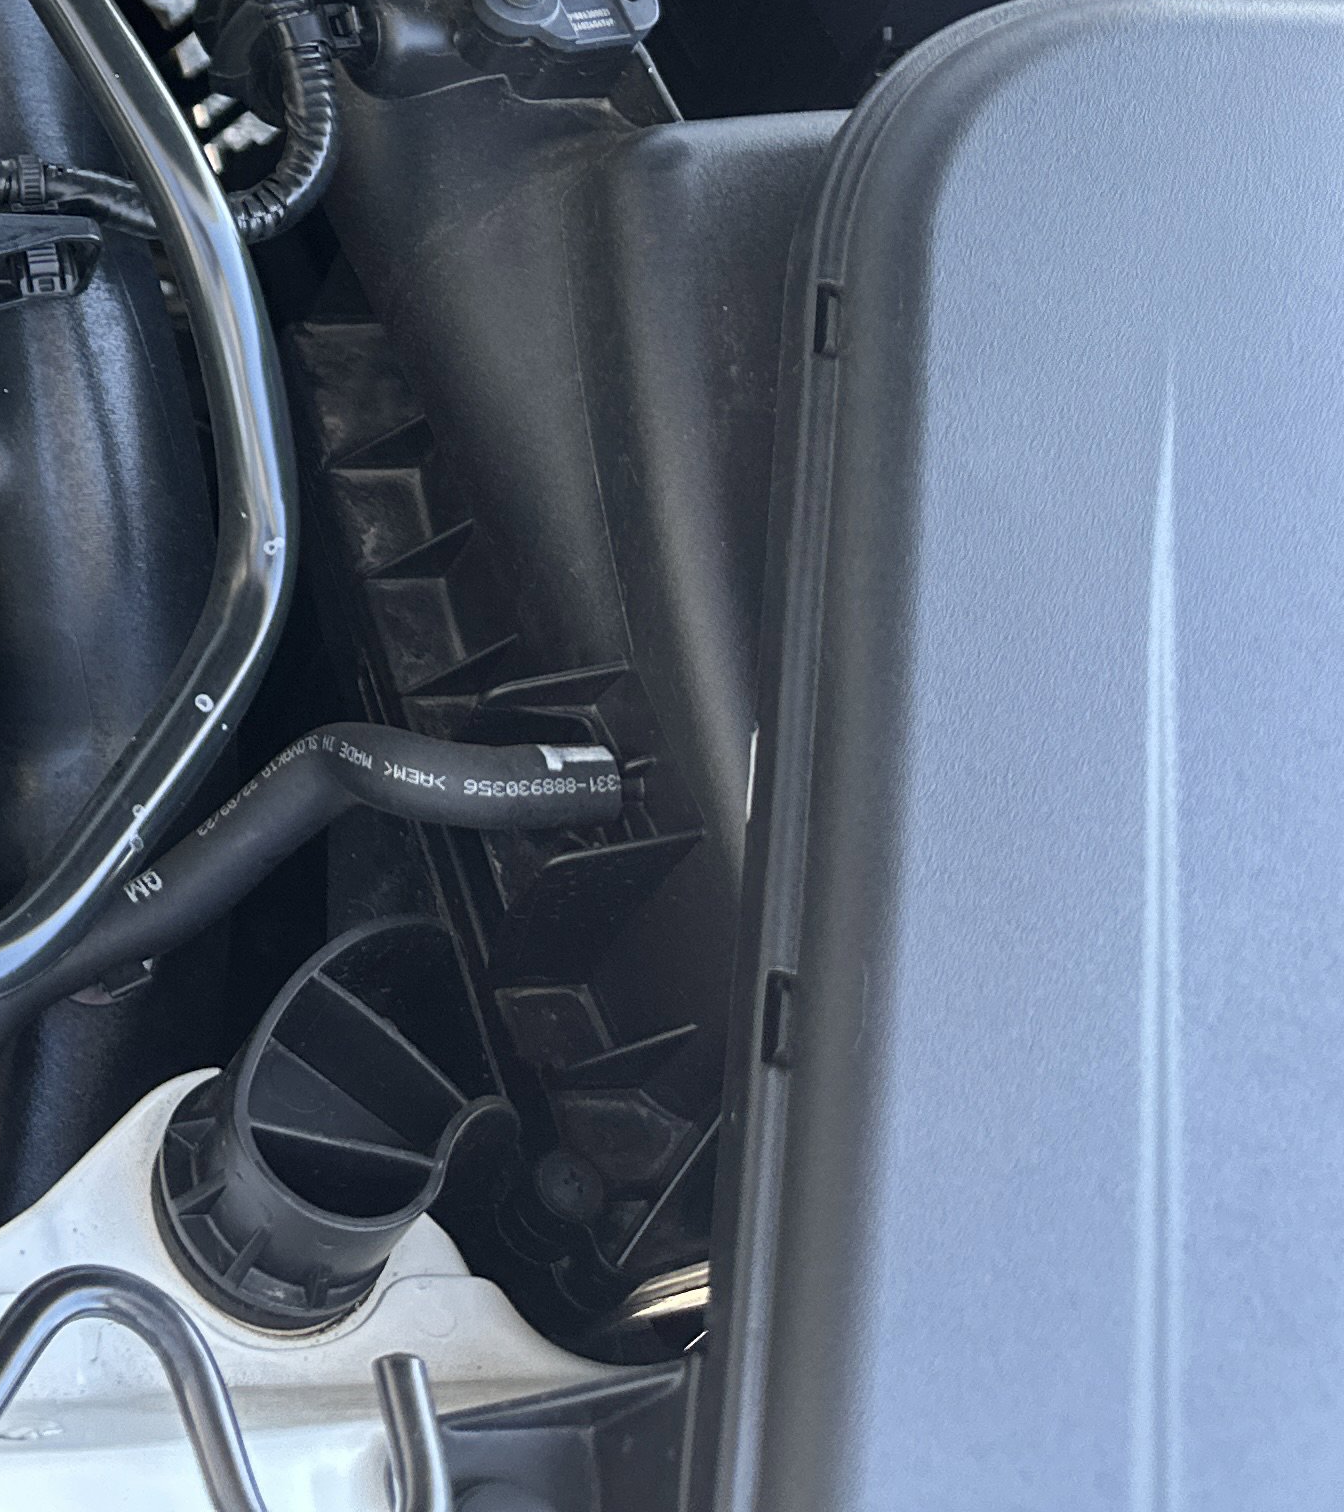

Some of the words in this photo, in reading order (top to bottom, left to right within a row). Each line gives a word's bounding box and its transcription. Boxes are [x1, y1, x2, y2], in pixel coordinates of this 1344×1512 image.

[261, 729, 319, 780] SLOVAKIA
[321, 733, 336, 753] IN
[339, 740, 375, 770] MADE
[123, 868, 165, 905] GM
